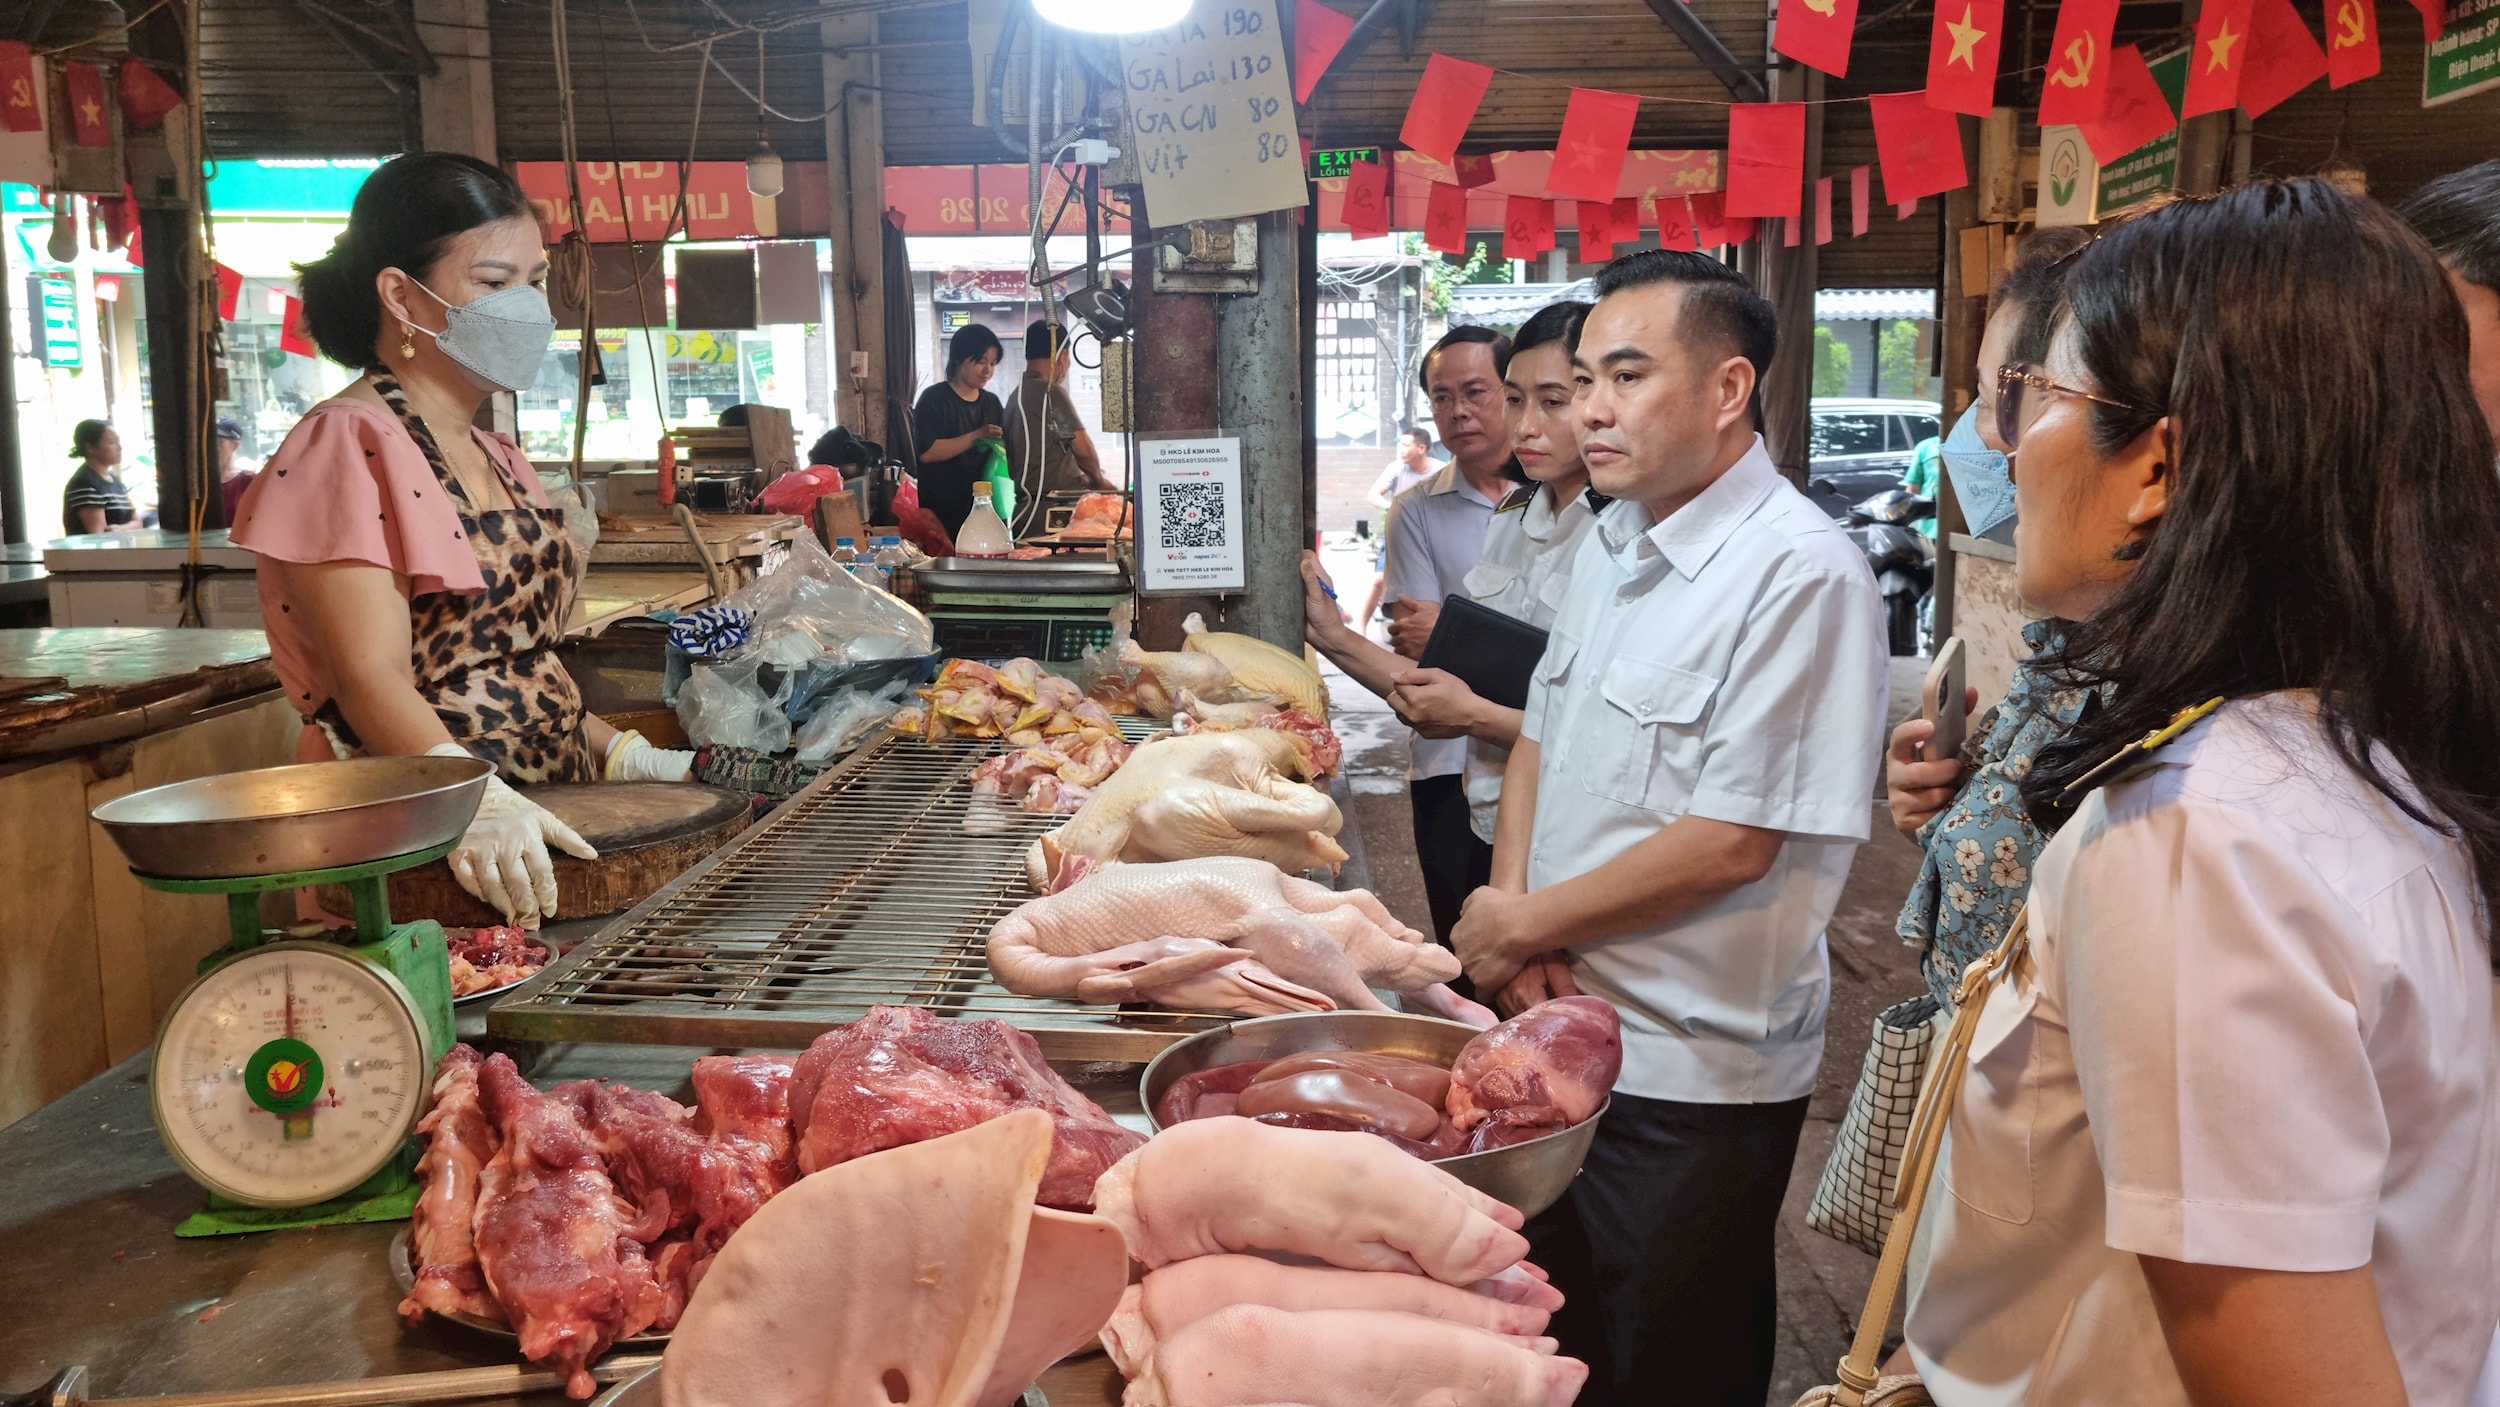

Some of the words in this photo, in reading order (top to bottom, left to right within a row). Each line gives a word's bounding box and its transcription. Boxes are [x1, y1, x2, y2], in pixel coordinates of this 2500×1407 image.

[1223, 8, 1263, 36] 190
[2486, 17, 2499, 37] SP
[1175, 57, 1216, 93] Lai
[1231, 55, 1272, 80] 130
[1181, 104, 1217, 133] CN
[1248, 97, 1280, 123] 80
[1258, 131, 1288, 164] 80
[1319, 149, 1370, 166] EXIT
